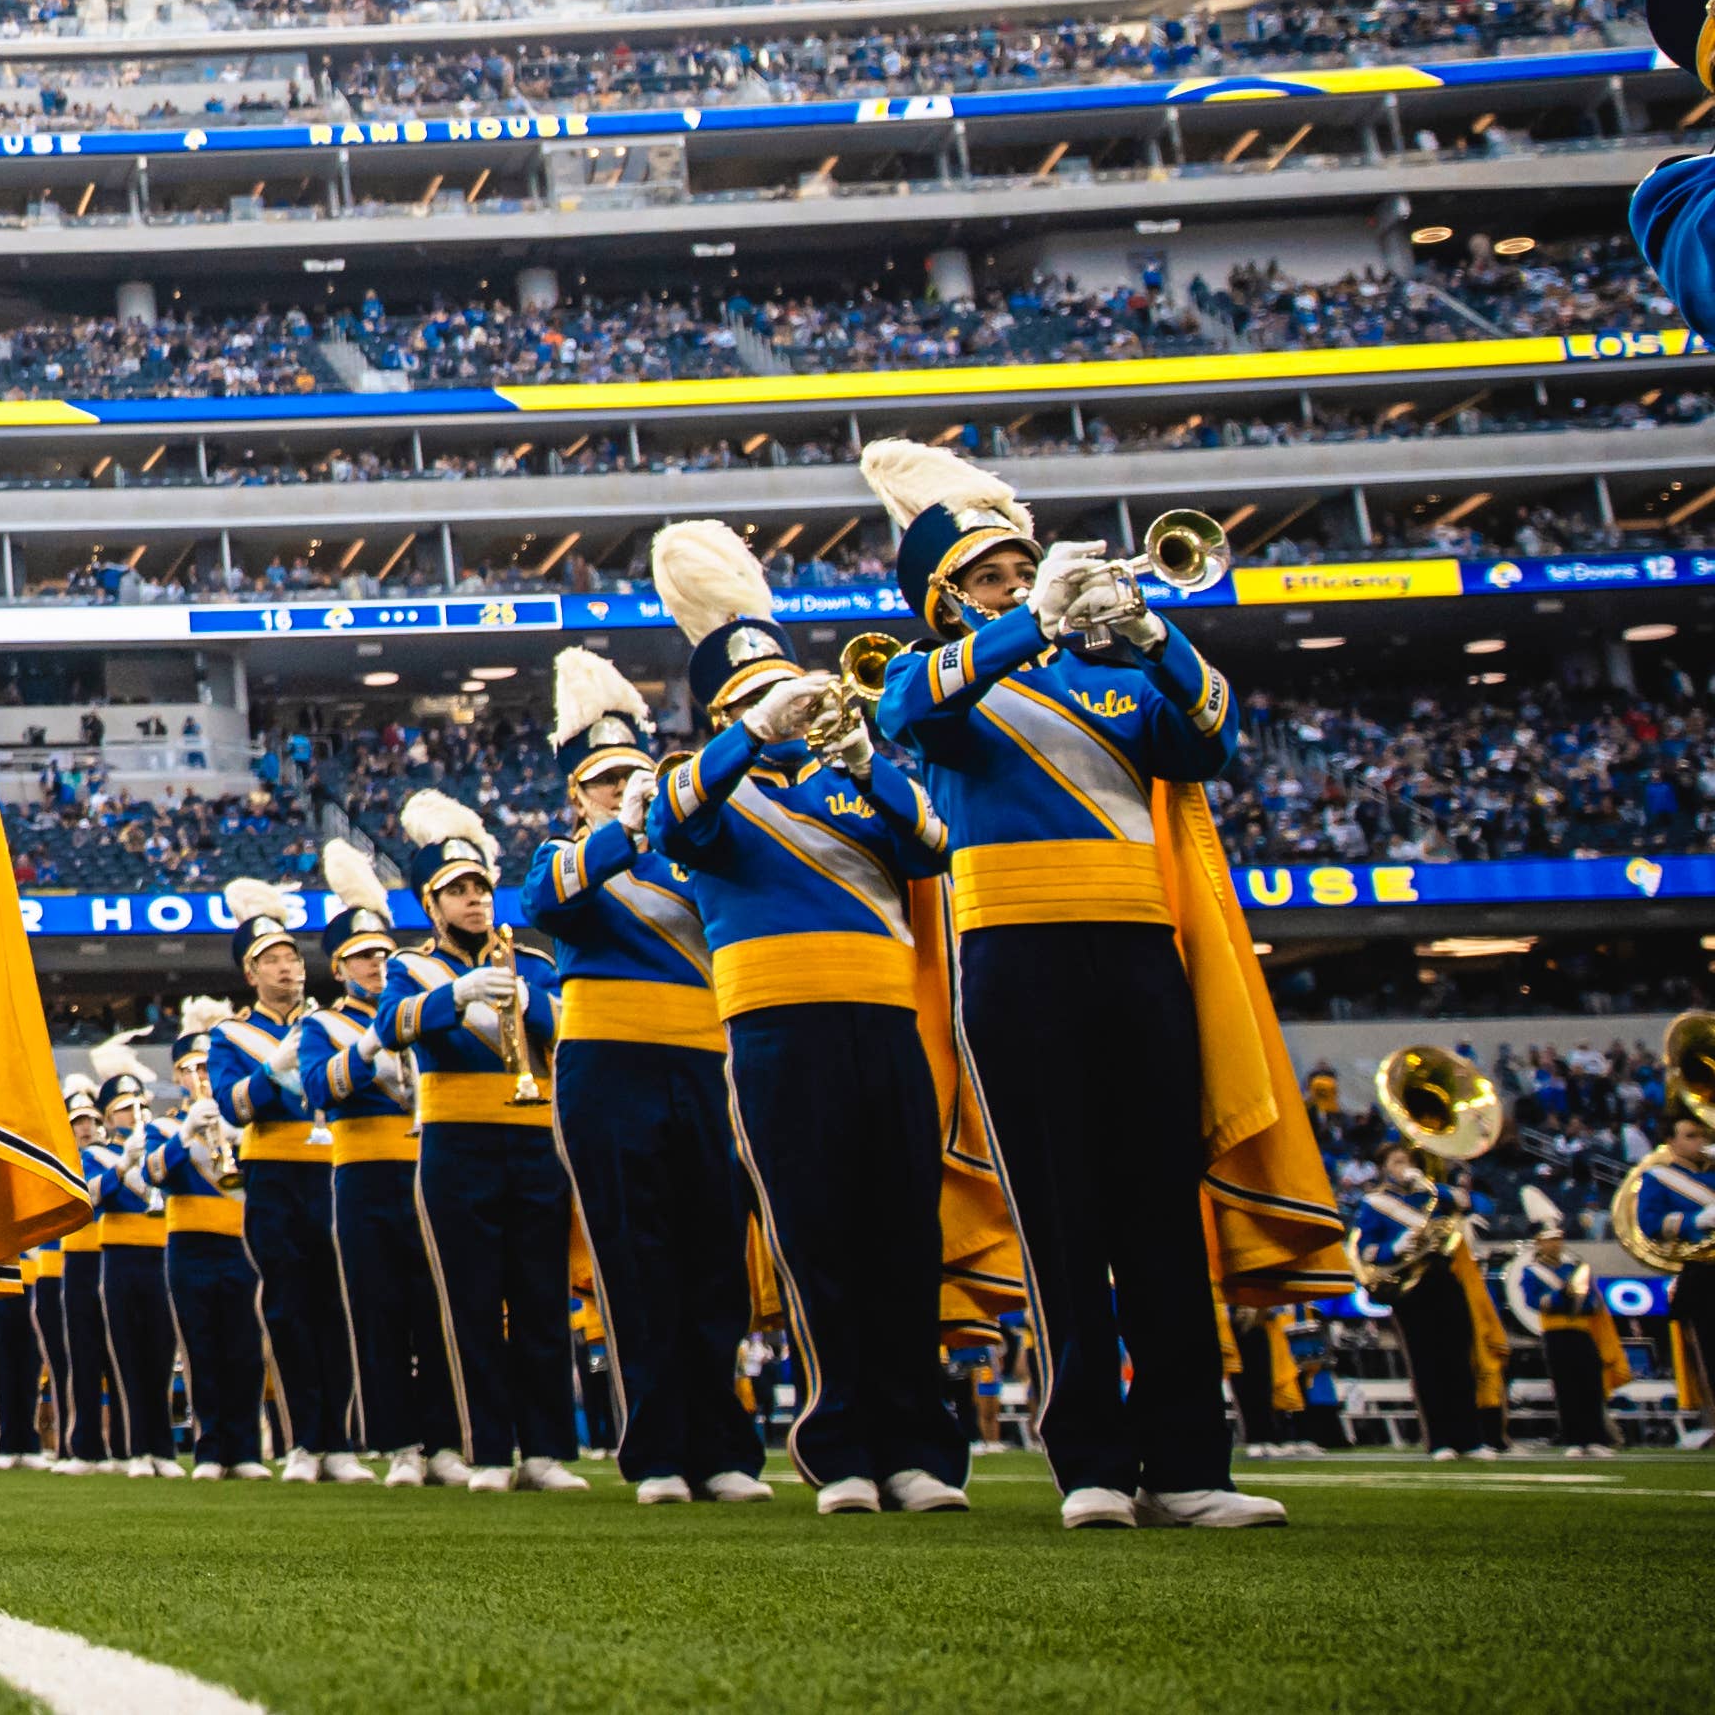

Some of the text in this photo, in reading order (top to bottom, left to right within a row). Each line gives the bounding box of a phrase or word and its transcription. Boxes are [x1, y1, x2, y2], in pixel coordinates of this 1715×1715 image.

[310, 115, 590, 146] RAMS HOUSE
[1643, 555, 1677, 580] 12
[1283, 573, 1412, 595] Efficiency
[261, 608, 292, 631] 16
[1249, 866, 1419, 906] USE
